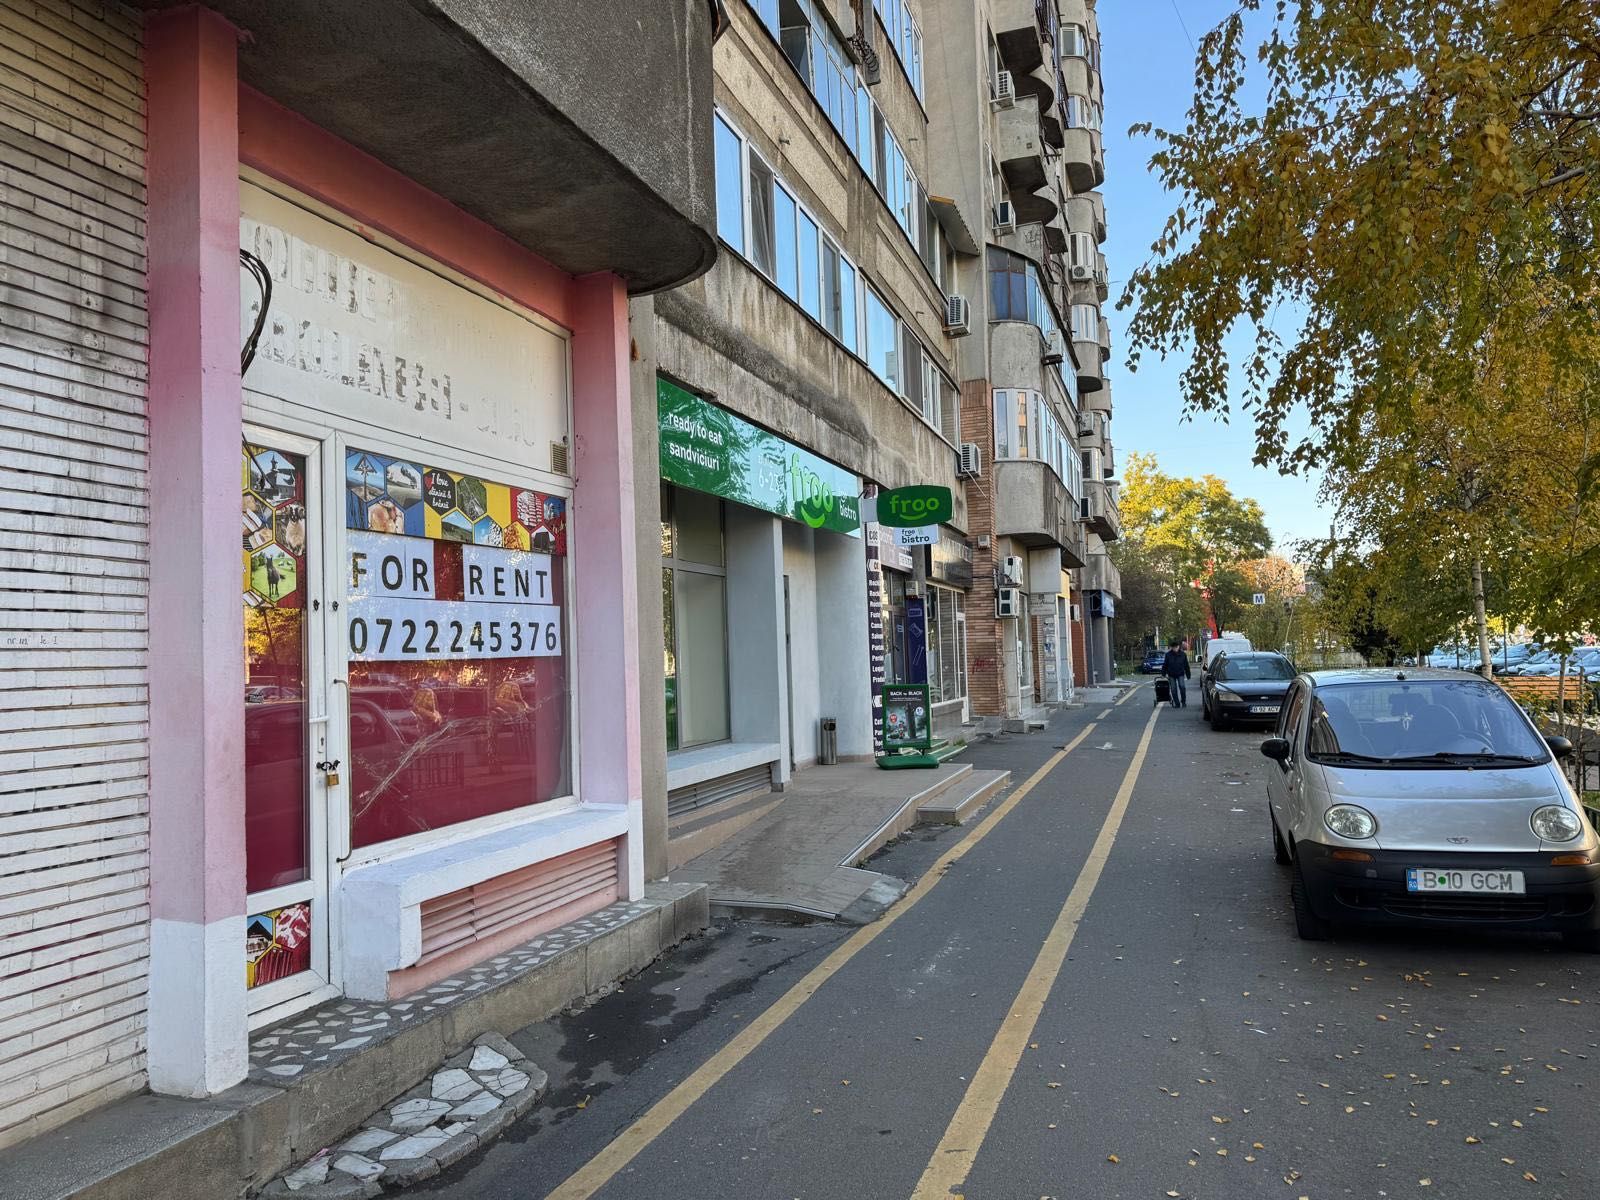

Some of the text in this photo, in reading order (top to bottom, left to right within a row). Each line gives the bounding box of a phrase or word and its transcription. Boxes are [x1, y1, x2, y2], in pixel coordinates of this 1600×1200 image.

[669, 412, 722, 445] ready to eat
[669, 442, 720, 471] sandviciuri
[431, 473, 449, 487] I love
[791, 452, 833, 513] froo
[840, 500, 857, 521] bistro
[889, 495, 940, 514] froo
[901, 536, 930, 544] bistro
[352, 552, 548, 598] FOR RENT
[1255, 595, 1264, 603] M
[350, 617, 557, 654] 0722245376
[1423, 871, 1437, 888] B
[1445, 872, 1463, 889] 10
[1471, 873, 1513, 890] GCM
